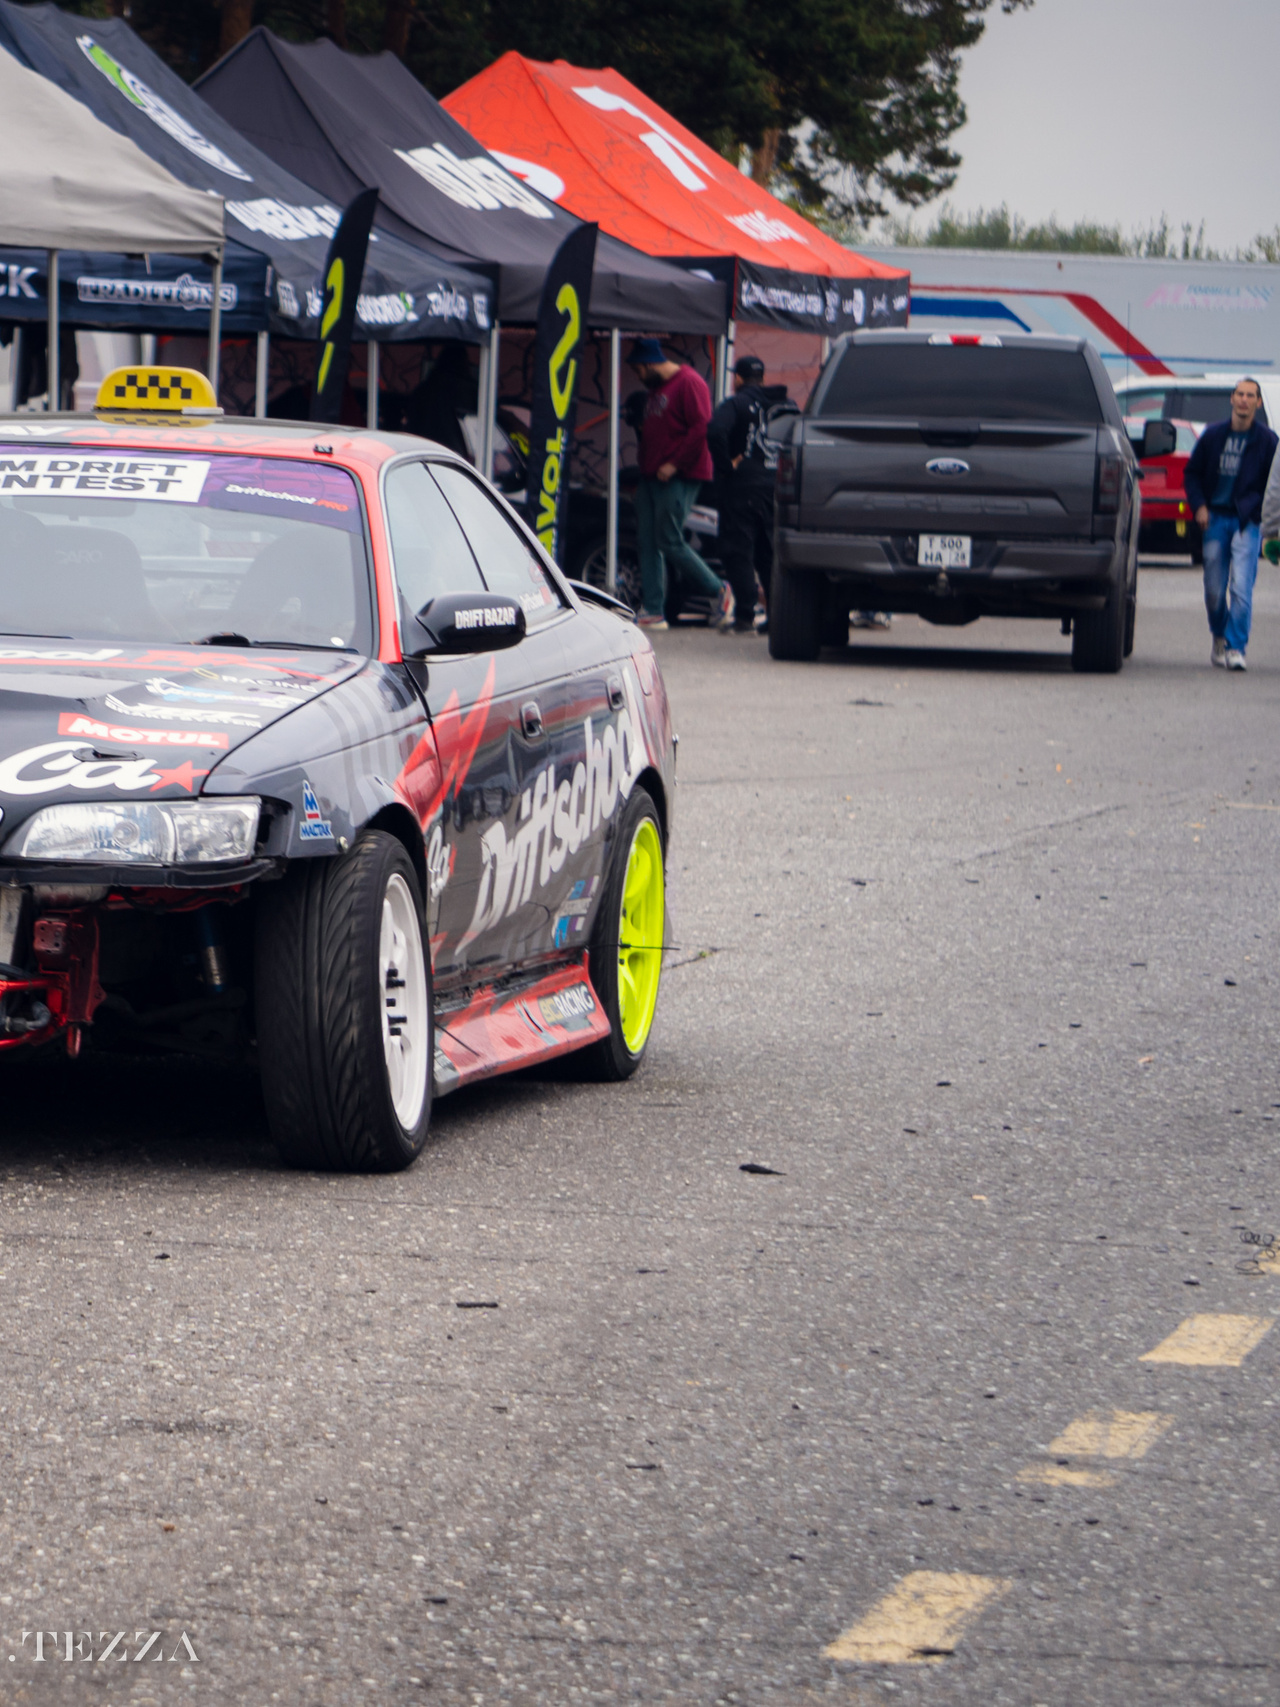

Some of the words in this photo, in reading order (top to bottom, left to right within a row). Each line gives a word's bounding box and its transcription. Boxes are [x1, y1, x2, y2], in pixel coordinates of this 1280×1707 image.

[47, 460, 187, 476] DRIFT
[454, 610, 483, 629] DRIFT
[483, 606, 516, 627] BAZAR
[68, 718, 220, 746] MOTUL
[553, 985, 595, 1018] RACING
